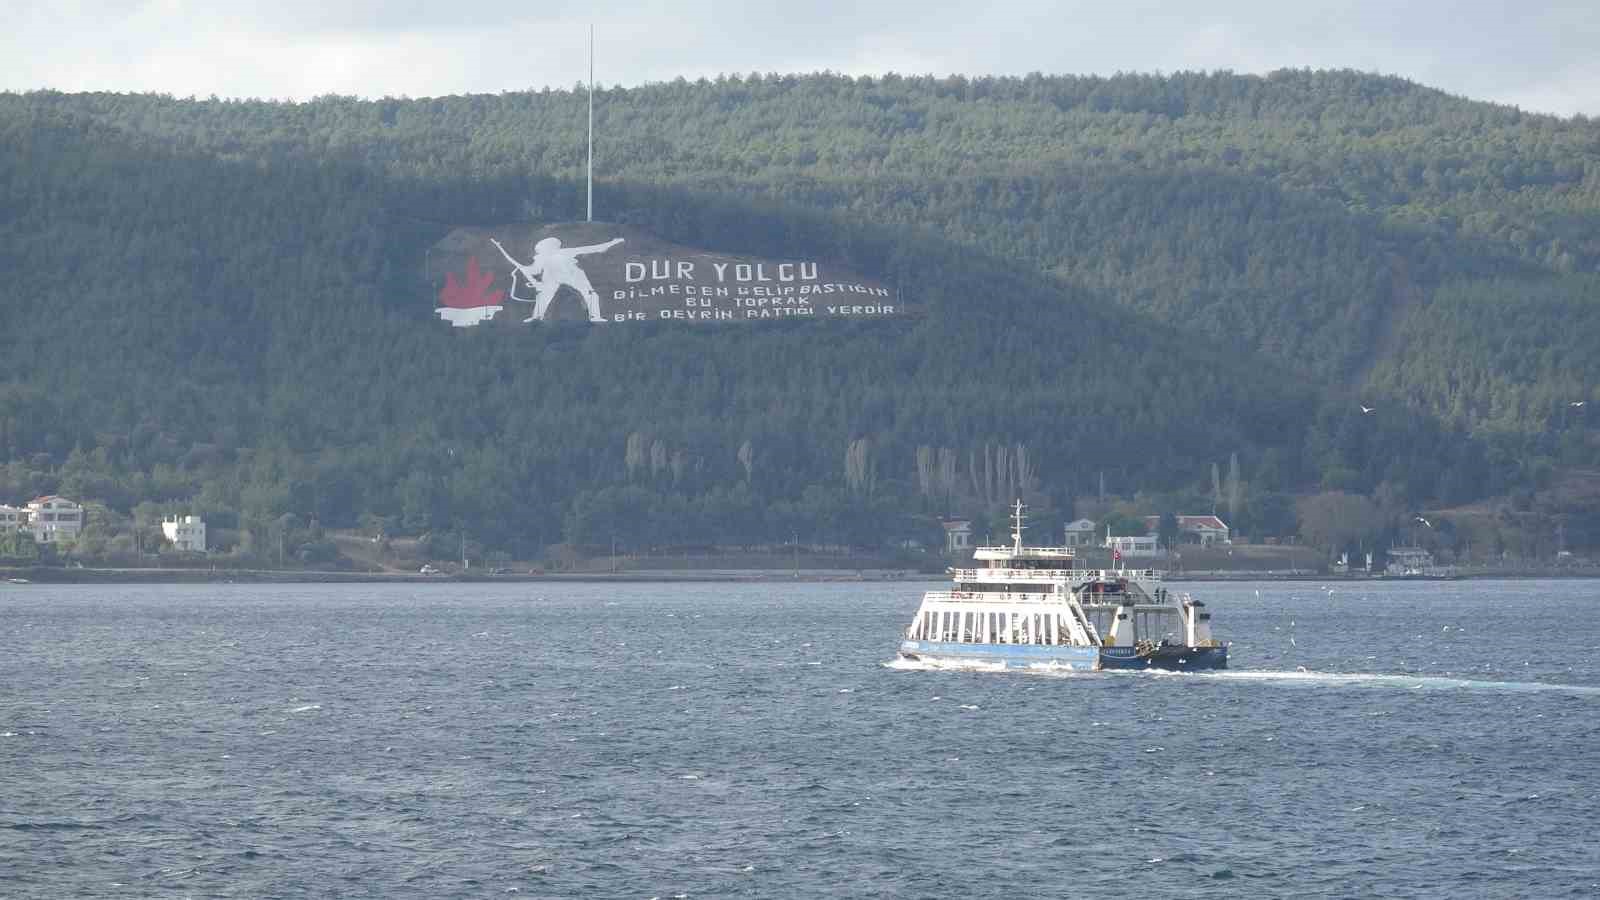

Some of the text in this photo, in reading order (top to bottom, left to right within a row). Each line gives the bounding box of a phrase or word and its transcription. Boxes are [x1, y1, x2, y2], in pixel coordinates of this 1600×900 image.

[625, 260, 818, 282] DUR YOLCU
[686, 296, 809, 307] BU TOPRAK
